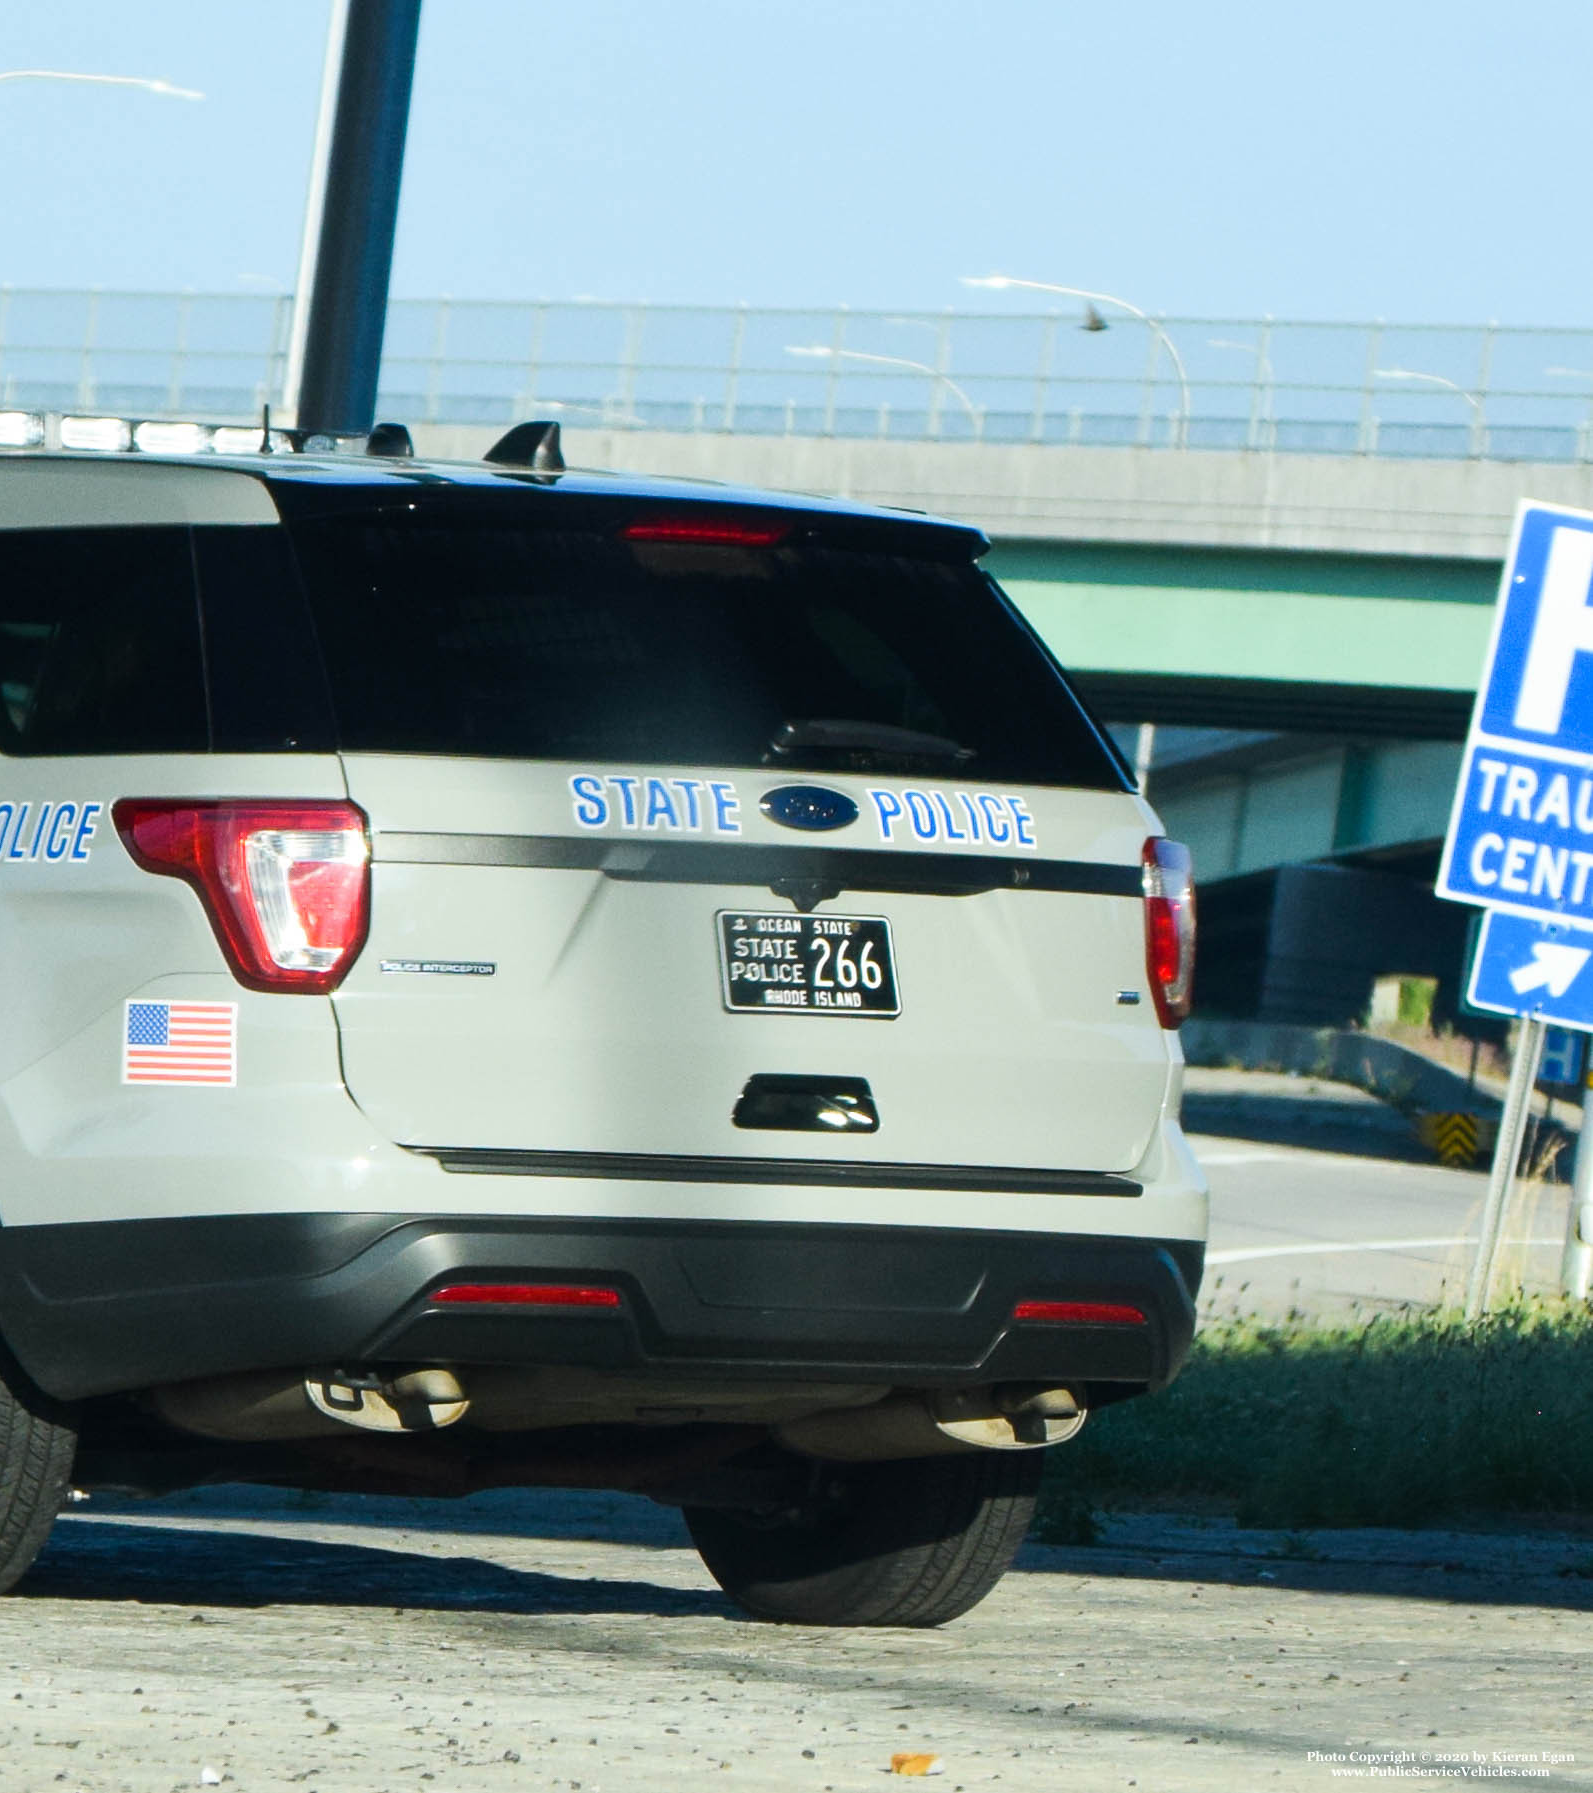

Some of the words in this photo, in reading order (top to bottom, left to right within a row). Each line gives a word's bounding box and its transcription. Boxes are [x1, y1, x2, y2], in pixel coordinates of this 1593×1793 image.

[568, 774, 742, 836] STATE
[865, 788, 1038, 849] POLICE
[757, 918, 802, 933] OCEAN
[813, 920, 853, 936] STATE
[733, 937, 798, 959] STATE
[730, 961, 806, 984] POLICE
[810, 938, 882, 989] 266
[764, 988, 808, 1006] RHODE
[814, 990, 862, 1008] ISLAND
